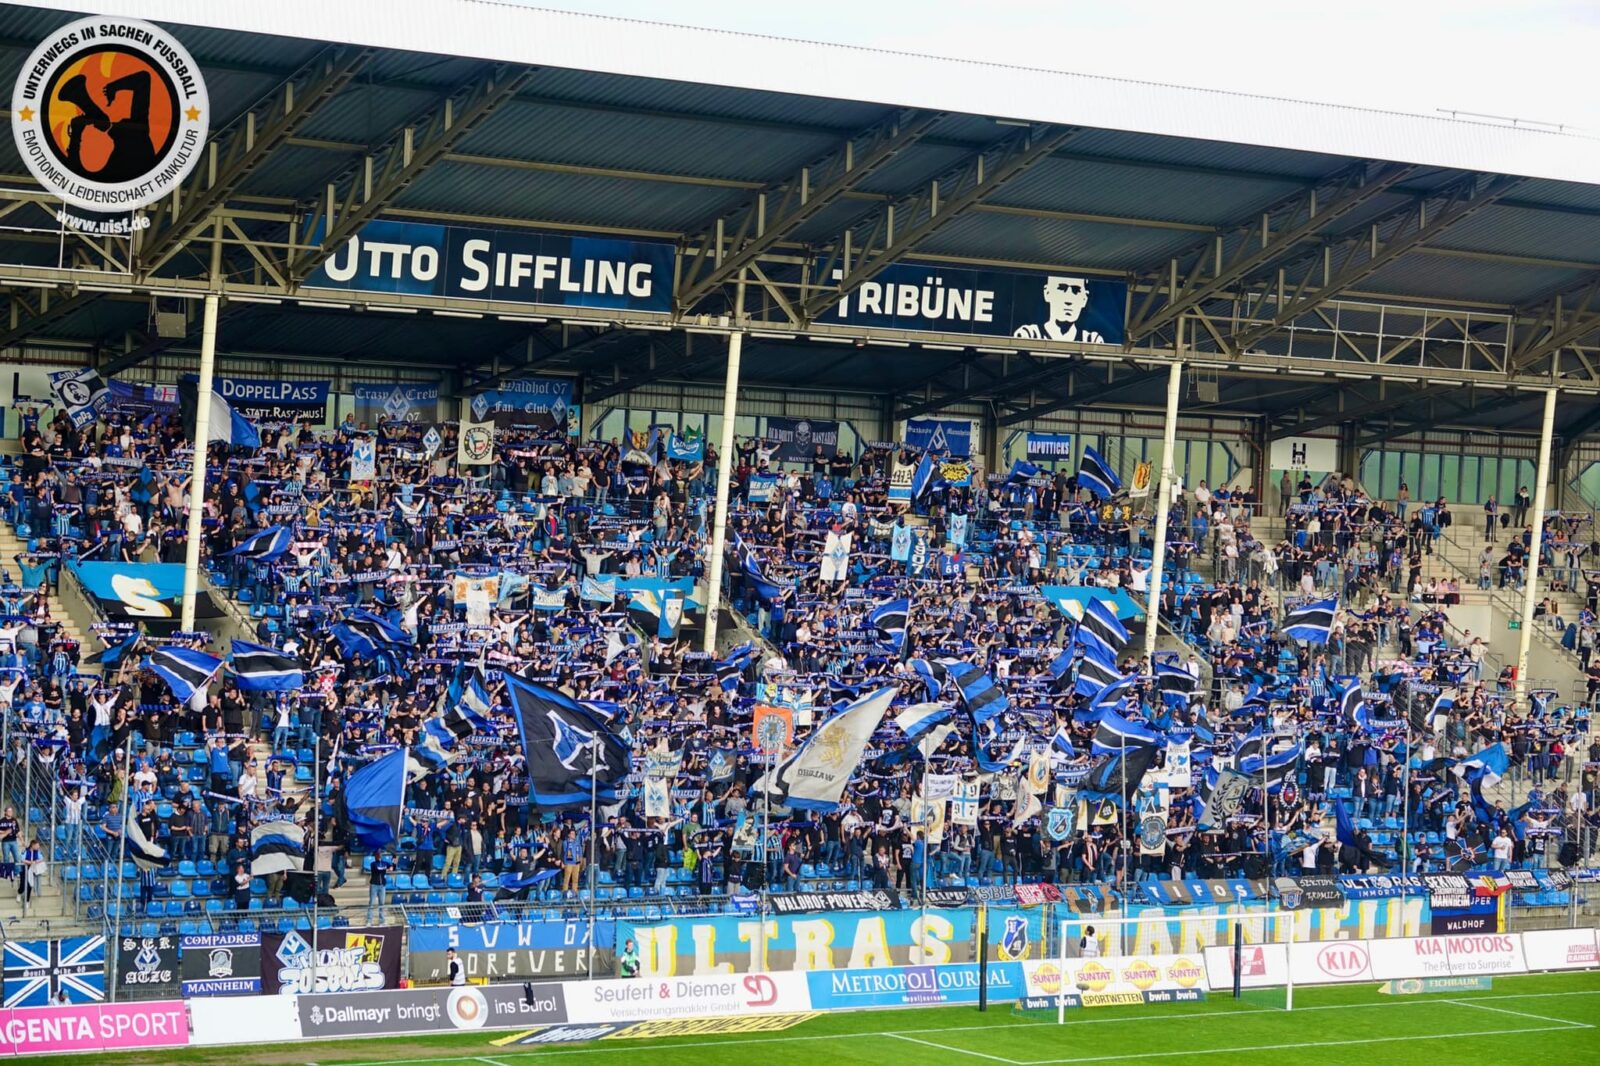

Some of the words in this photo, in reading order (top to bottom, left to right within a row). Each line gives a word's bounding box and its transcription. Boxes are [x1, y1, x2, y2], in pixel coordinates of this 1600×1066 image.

[406, 389, 438, 401] Crew
[552, 383, 567, 396] 07
[492, 401, 514, 413] Fan
[1027, 440, 1070, 455] KAPUTTICKS
[1149, 882, 1267, 898] TIFOSI
[1430, 894, 1471, 908] MANNHEIM
[448, 908, 460, 917] 12
[1447, 920, 1485, 931] WALDHOF
[185, 933, 259, 946] COMPADRES
[634, 913, 953, 976] ULTRAS
[1415, 939, 1443, 955] KIA
[1448, 935, 1513, 954] MOTORS
[1325, 952, 1359, 970] KIA
[1424, 961, 1438, 972] The
[1439, 961, 1467, 971] Power
[1467, 959, 1477, 970] to
[1477, 957, 1512, 970] Surprise
[1077, 971, 1111, 982] SUNTAT
[1123, 969, 1157, 980] SUNTAT
[1168, 967, 1202, 979] SUNTAT
[187, 981, 254, 993] MANNHEIM
[594, 982, 653, 1002] Seufert
[659, 983, 671, 999] &
[676, 980, 736, 998] Diemer
[1026, 997, 1049, 1009] bwin
[1083, 992, 1143, 1006] SPORTWETTEN
[1149, 990, 1170, 1002] bwin
[1176, 989, 1198, 1000] bwin
[325, 1005, 391, 1024] Dallmayr
[494, 999, 515, 1014] ins
[519, 995, 557, 1013] Büro!
[610, 1003, 708, 1018] Versicherungsmakler
[710, 1001, 740, 1013] GmbH
[99, 1011, 181, 1039] SPORT
